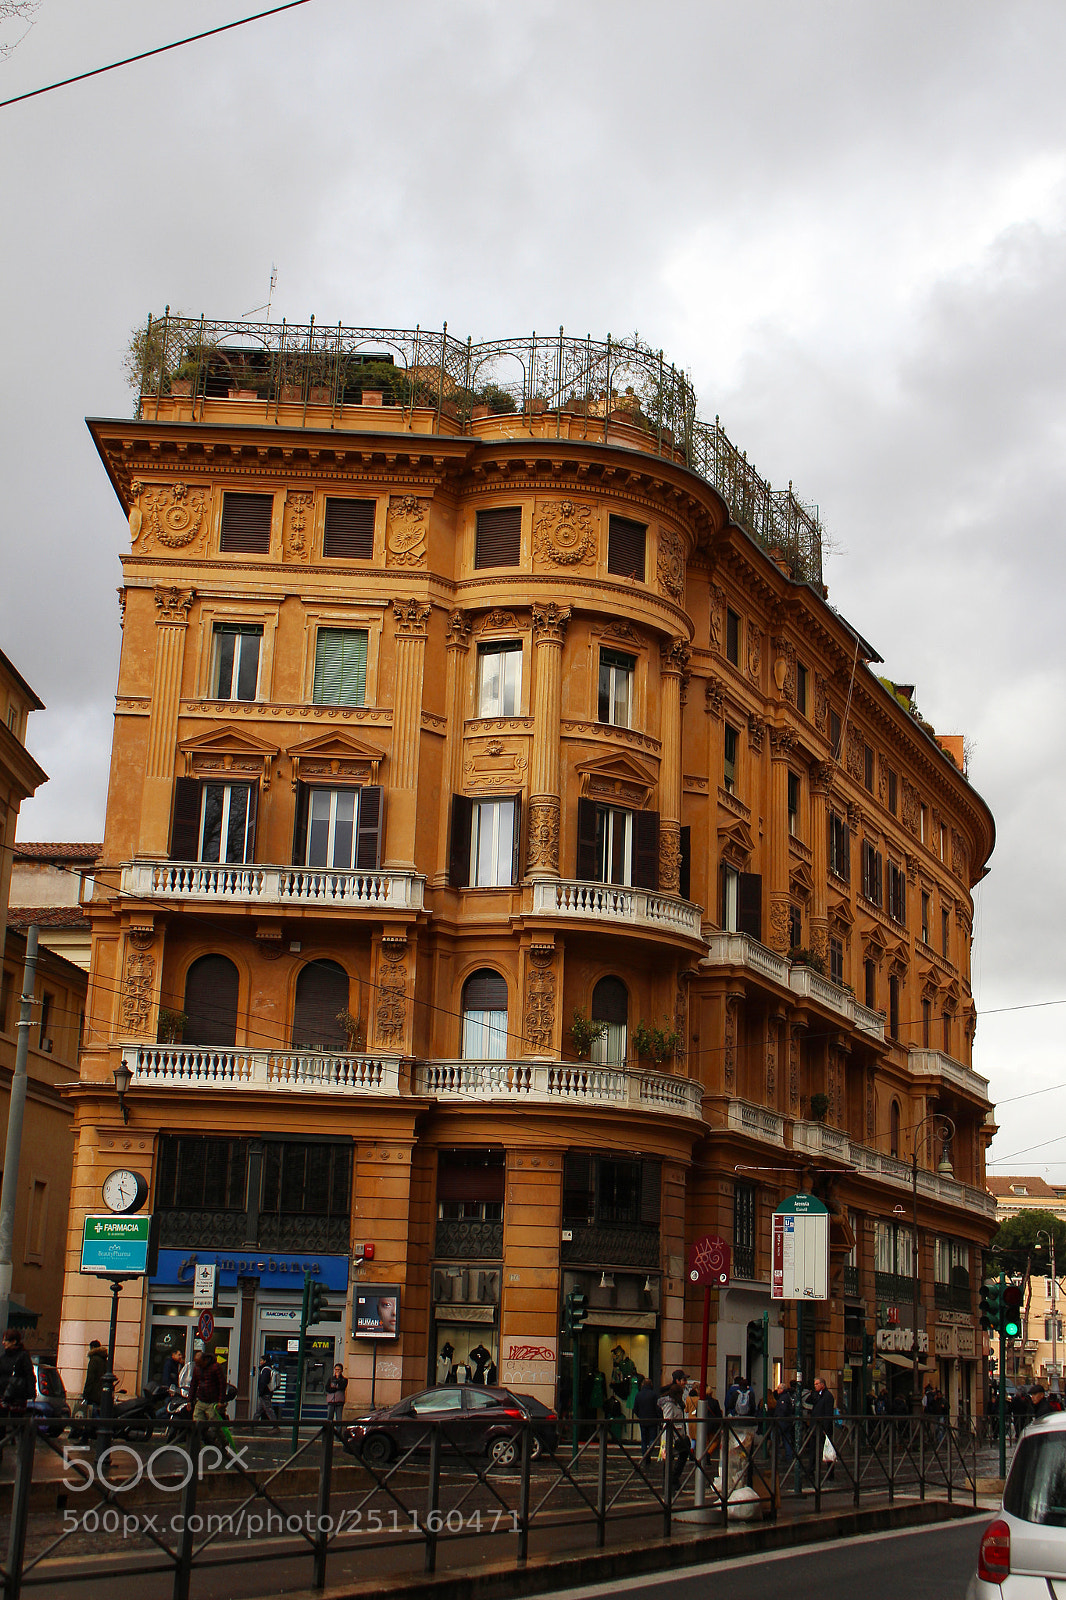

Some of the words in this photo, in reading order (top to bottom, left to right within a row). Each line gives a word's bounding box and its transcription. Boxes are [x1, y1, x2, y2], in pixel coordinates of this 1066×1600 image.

[104, 1223, 139, 1232] FARMACIA
[215, 1254, 321, 1275] imprebanca
[434, 1270, 497, 1301] NIK
[312, 1341, 330, 1349] ATM
[877, 1327, 929, 1352] cartolia
